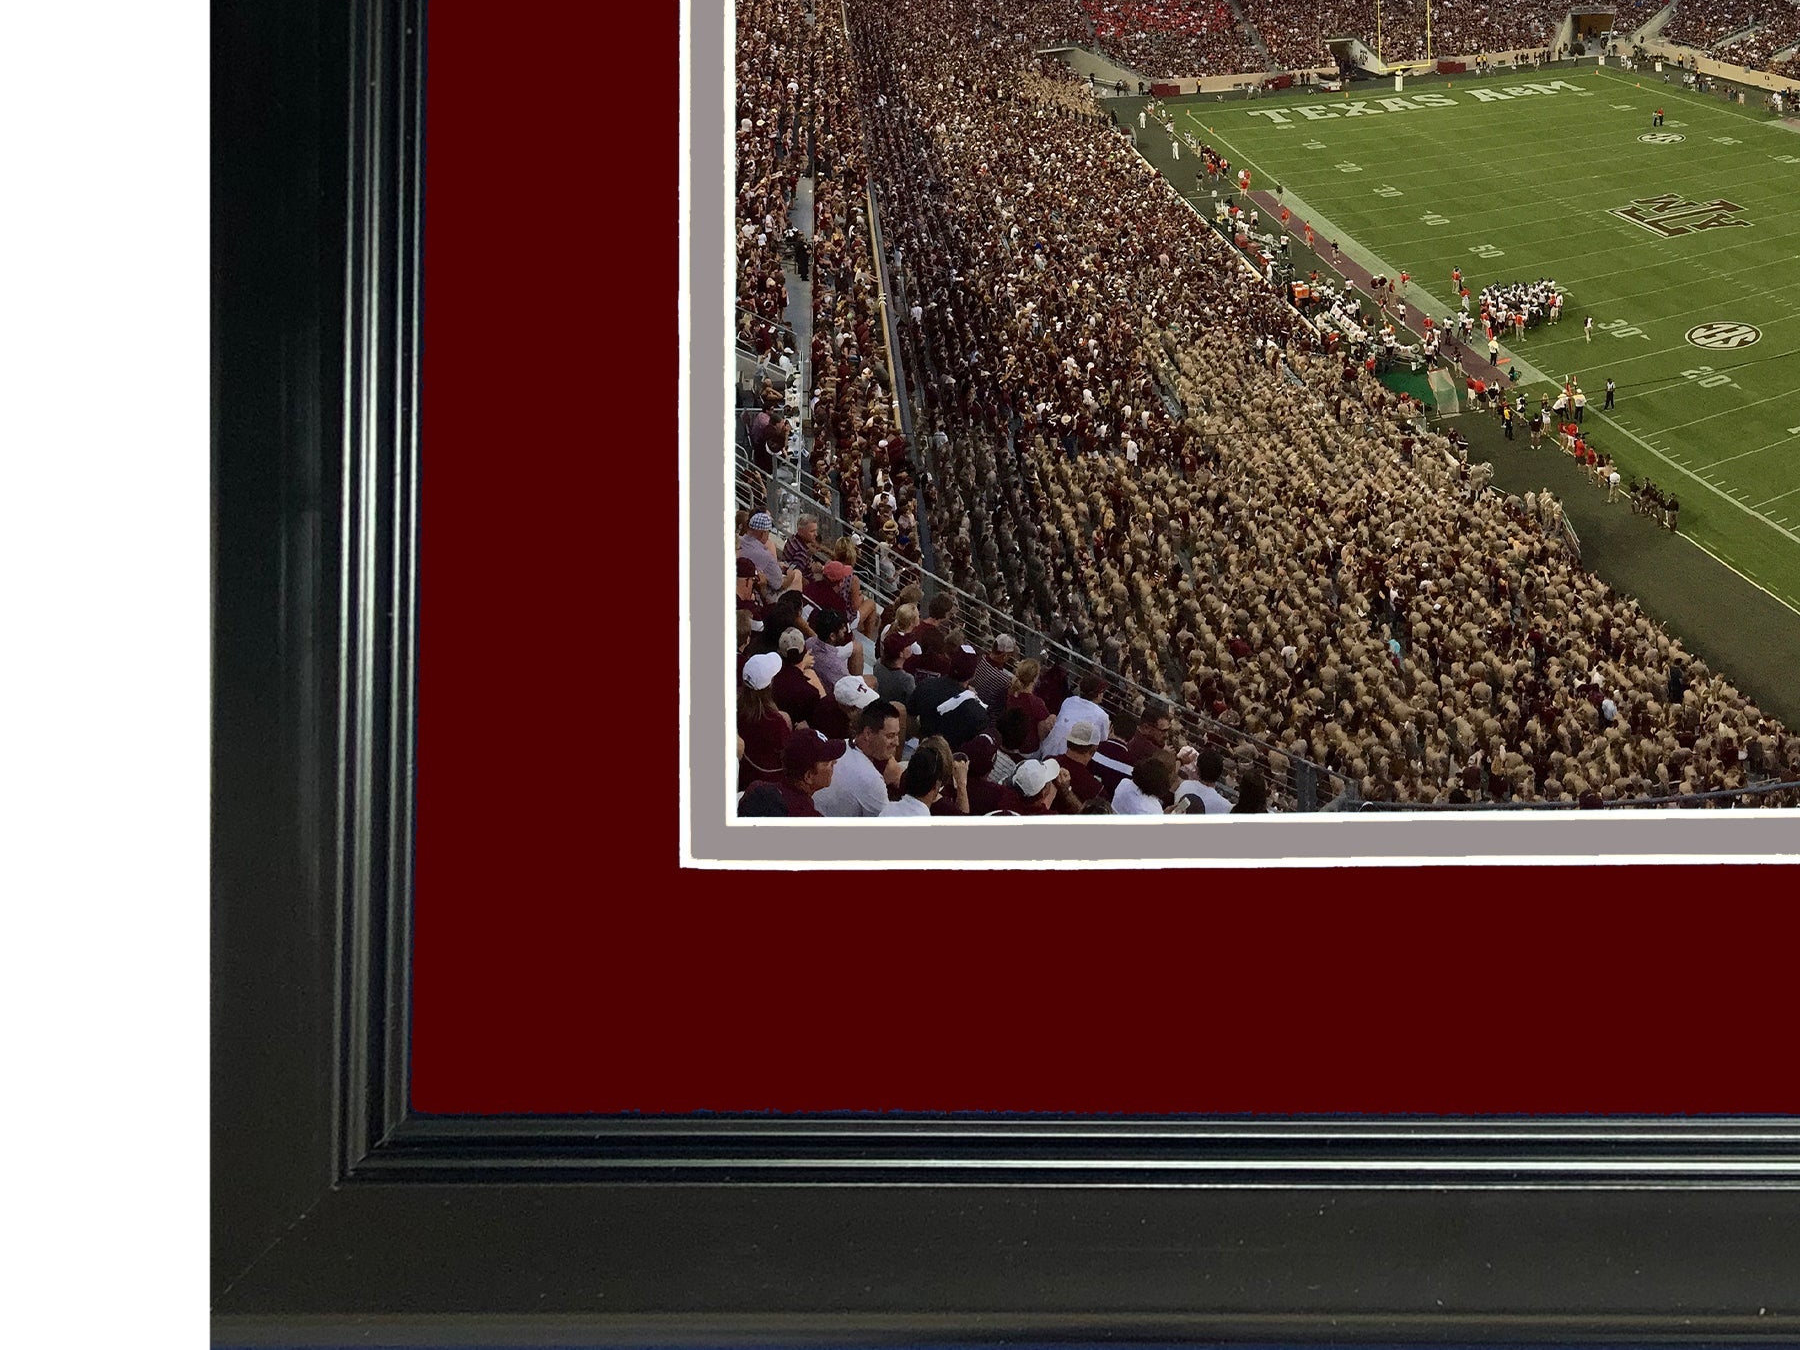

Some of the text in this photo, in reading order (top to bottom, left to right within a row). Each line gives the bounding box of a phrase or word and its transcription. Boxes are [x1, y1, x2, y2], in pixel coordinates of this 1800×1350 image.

[1247, 80, 1586, 123] TEXAS A&M
[1468, 244, 1505, 258] 50
[1598, 319, 1643, 338] 30
[1680, 366, 1732, 388] 20
